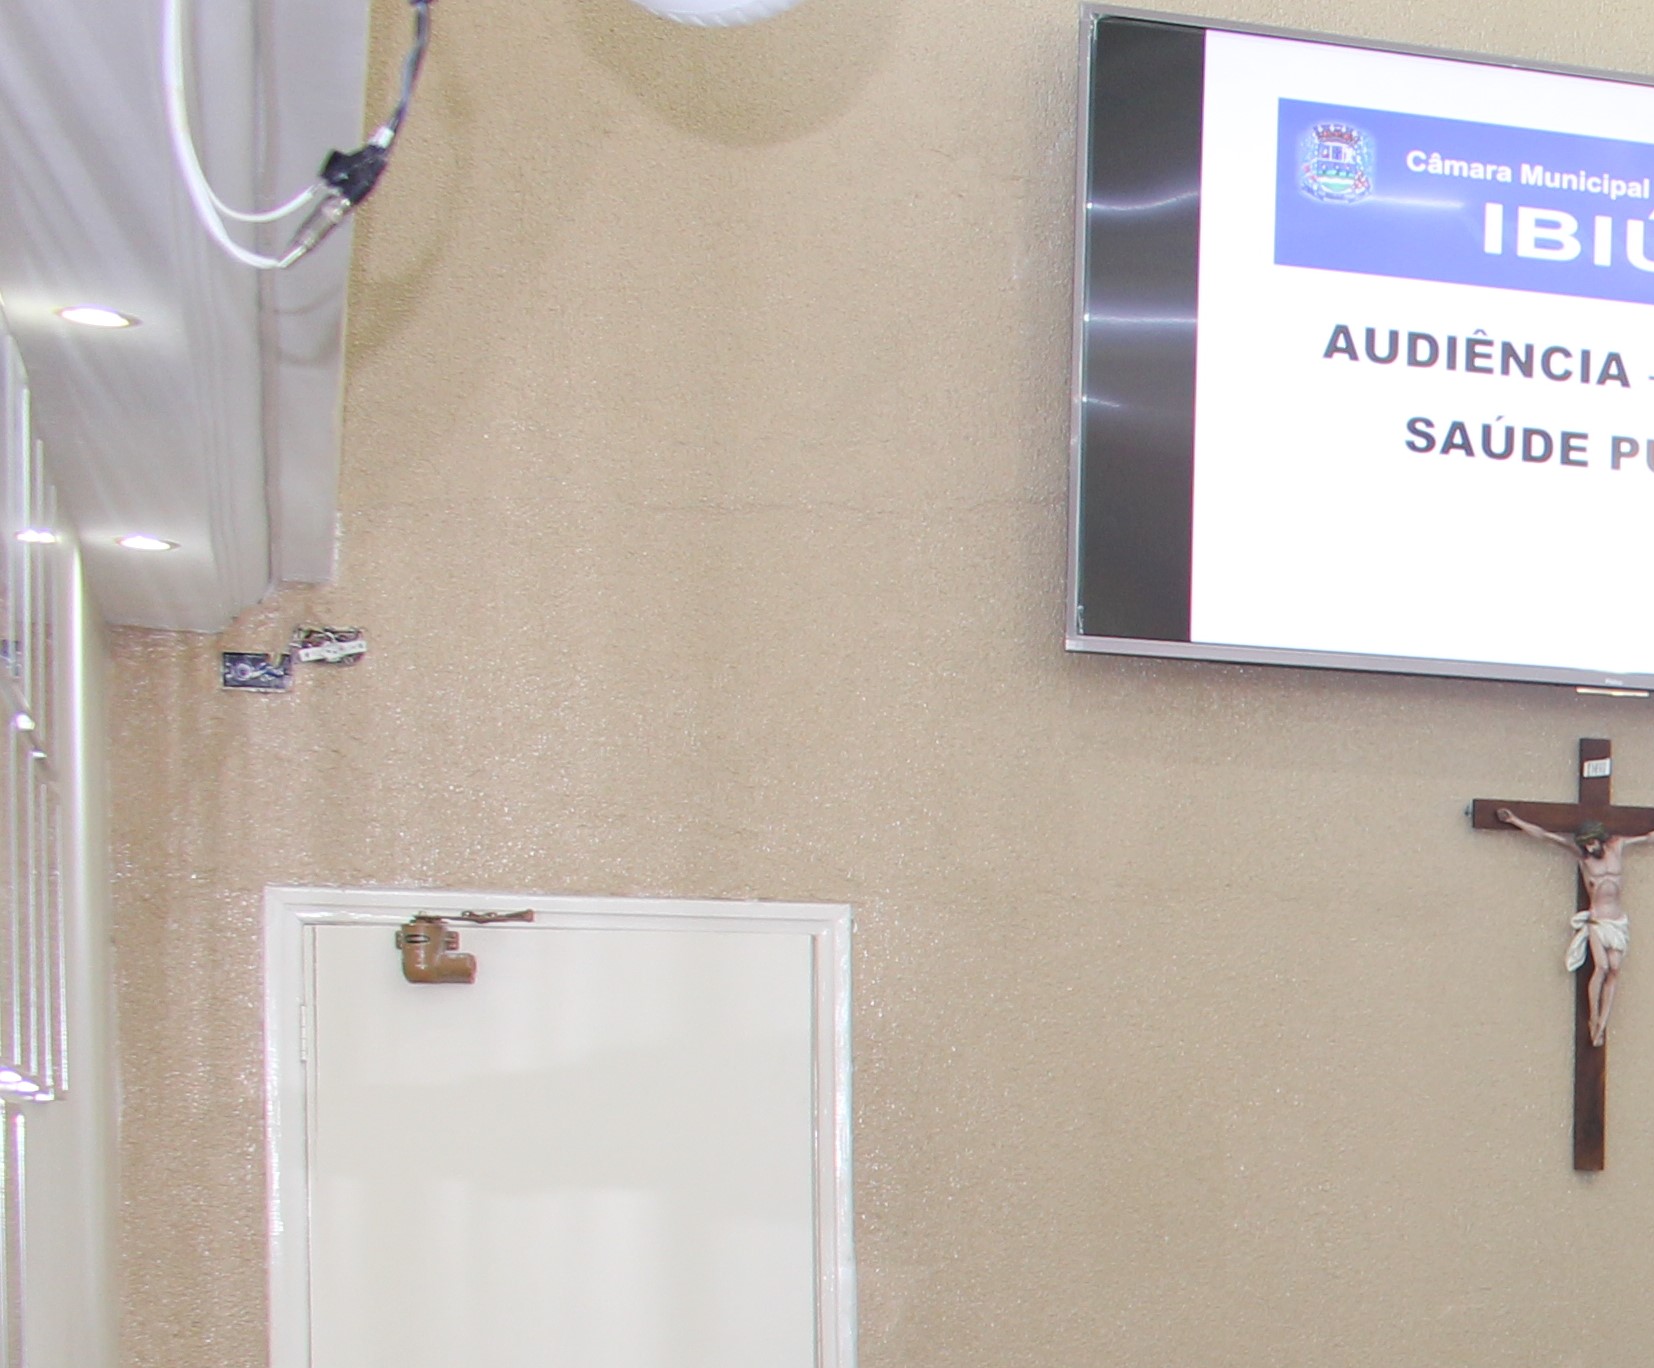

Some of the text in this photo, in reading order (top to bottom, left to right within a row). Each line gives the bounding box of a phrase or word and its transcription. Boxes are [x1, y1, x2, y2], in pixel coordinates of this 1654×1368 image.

[1405, 148, 1513, 183] Câmara
[1520, 162, 1651, 201] Municipal
[1323, 323, 1631, 388] AUDIÊNCIA
[1405, 415, 1589, 468] SAÚDE
